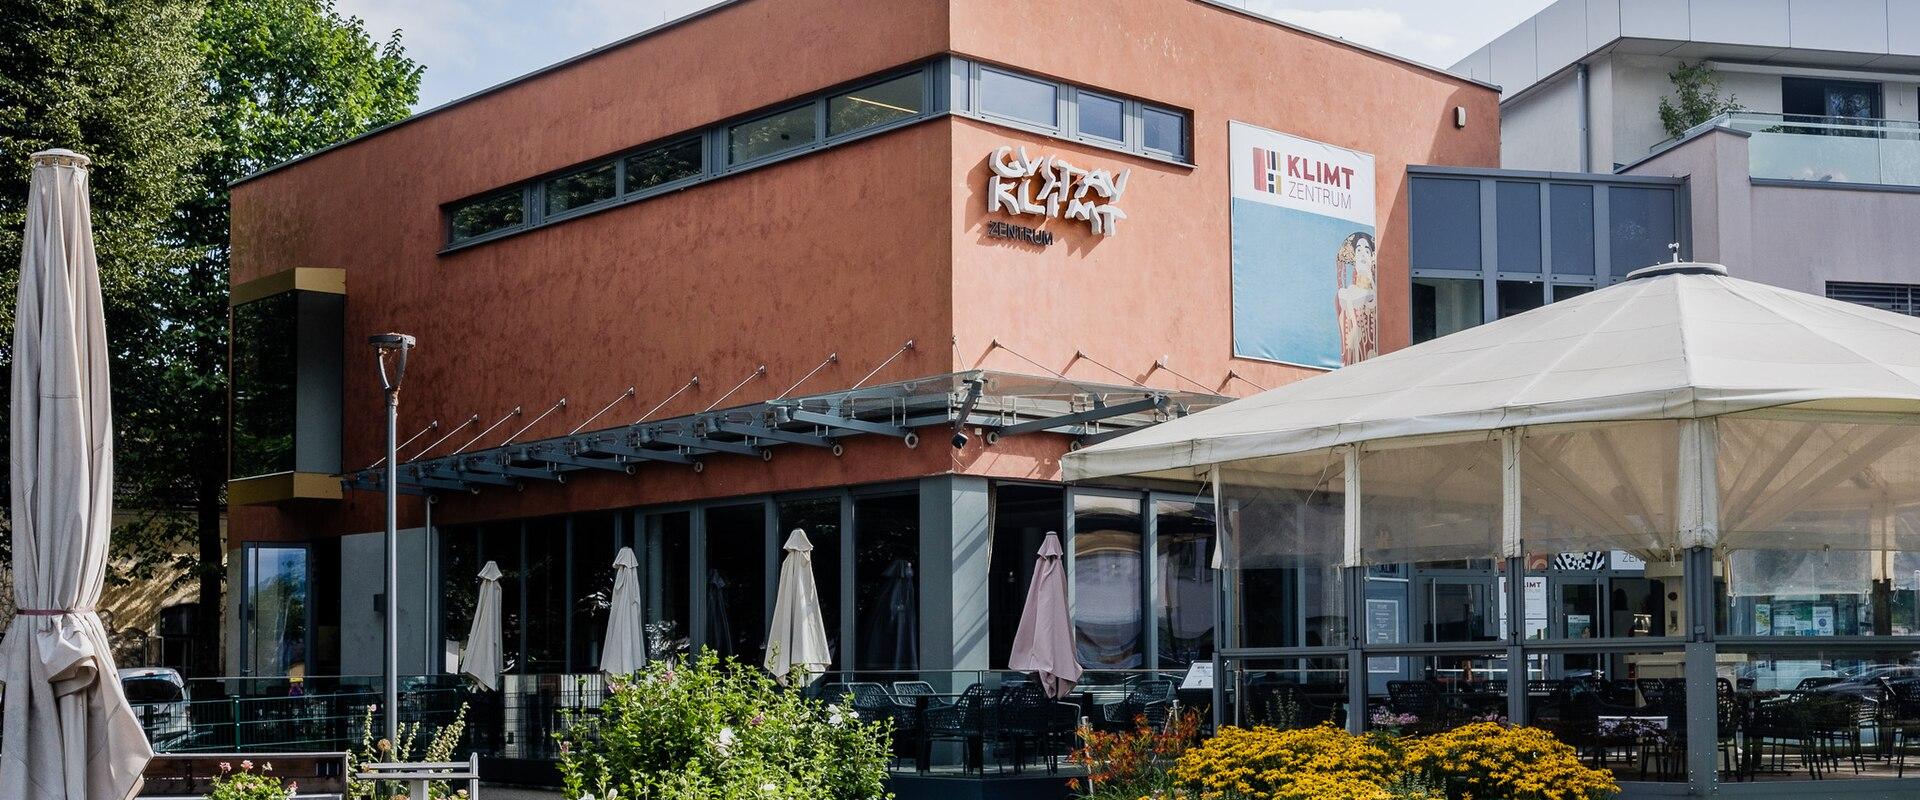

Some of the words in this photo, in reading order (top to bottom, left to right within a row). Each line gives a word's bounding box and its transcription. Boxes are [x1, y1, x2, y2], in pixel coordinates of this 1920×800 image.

[1287, 154, 1354, 190] KLIMT
[988, 174, 1127, 236] KLIMT
[1288, 180, 1352, 210] ZENTRUM
[988, 220, 1053, 246] ZENTRUM
